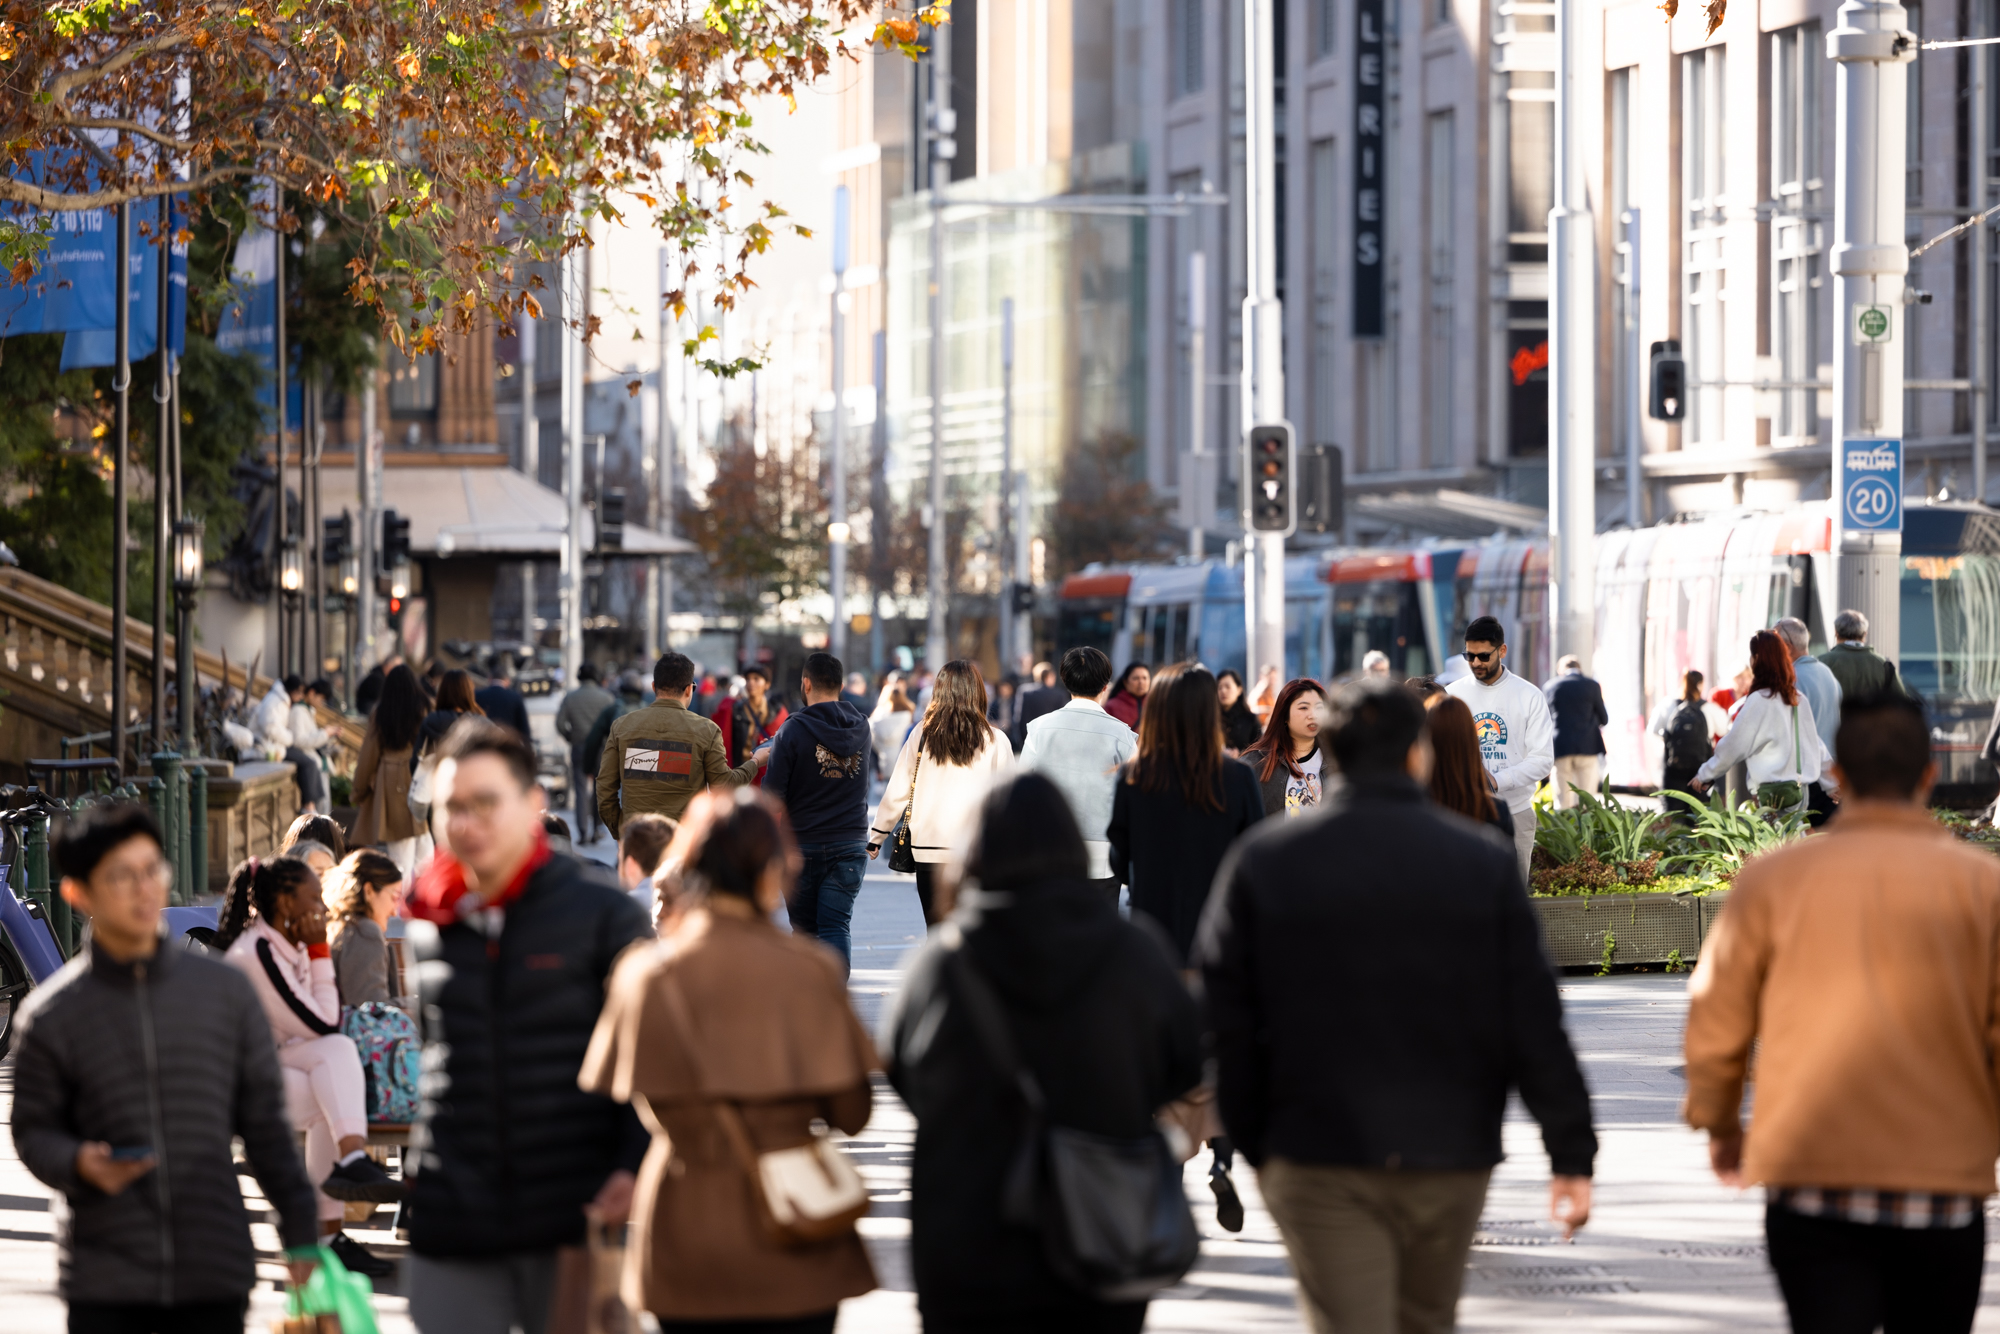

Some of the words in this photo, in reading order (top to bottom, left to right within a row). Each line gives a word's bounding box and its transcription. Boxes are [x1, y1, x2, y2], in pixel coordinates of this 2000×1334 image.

[1856, 487, 1887, 515] 20
[1474, 713, 1488, 722] URF
[1490, 713, 1507, 740] RIDERS
[631, 740, 690, 751] TOMMY
